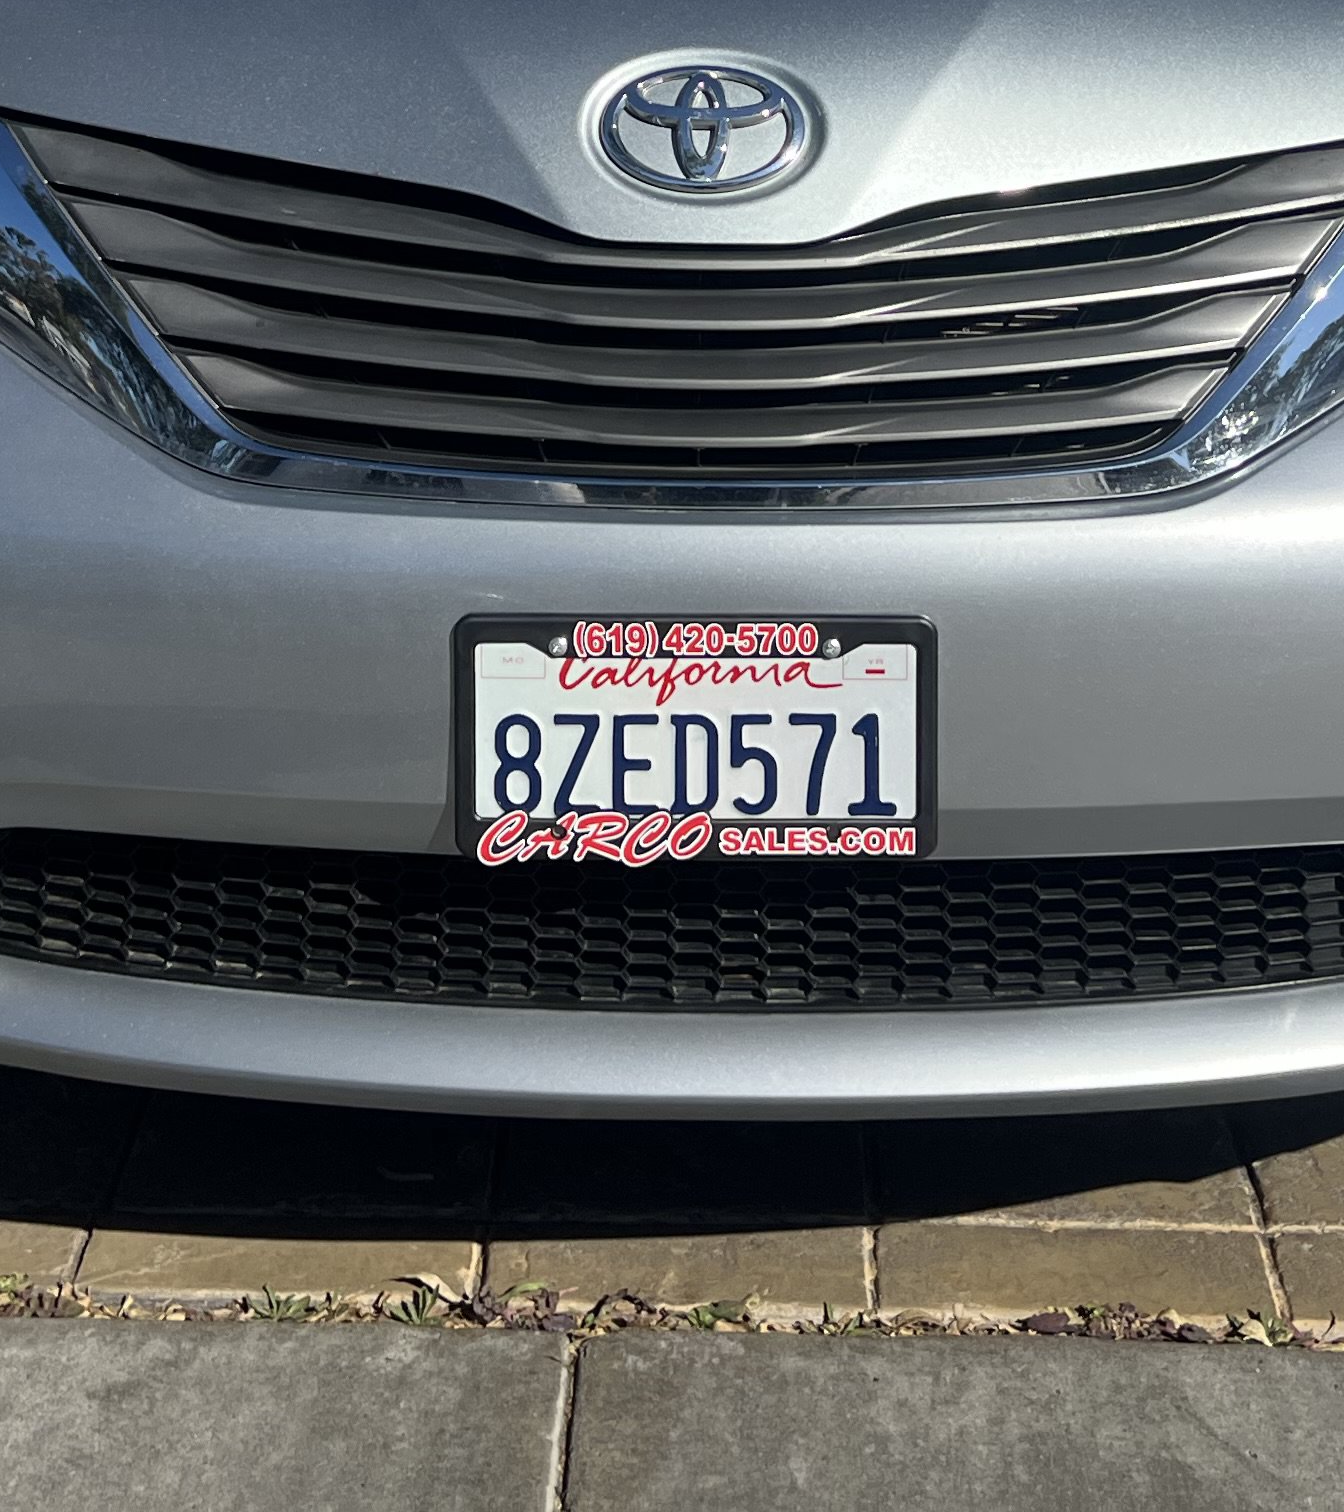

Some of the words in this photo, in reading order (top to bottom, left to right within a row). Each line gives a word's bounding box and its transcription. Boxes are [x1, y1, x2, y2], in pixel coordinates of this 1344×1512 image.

[573, 621, 657, 657] (619)
[662, 622, 818, 657] 420-5700
[558, 655, 844, 706] California
[493, 712, 898, 816] 8ZED571
[477, 809, 713, 867] CARCO
[719, 826, 916, 854] SALES.COM
